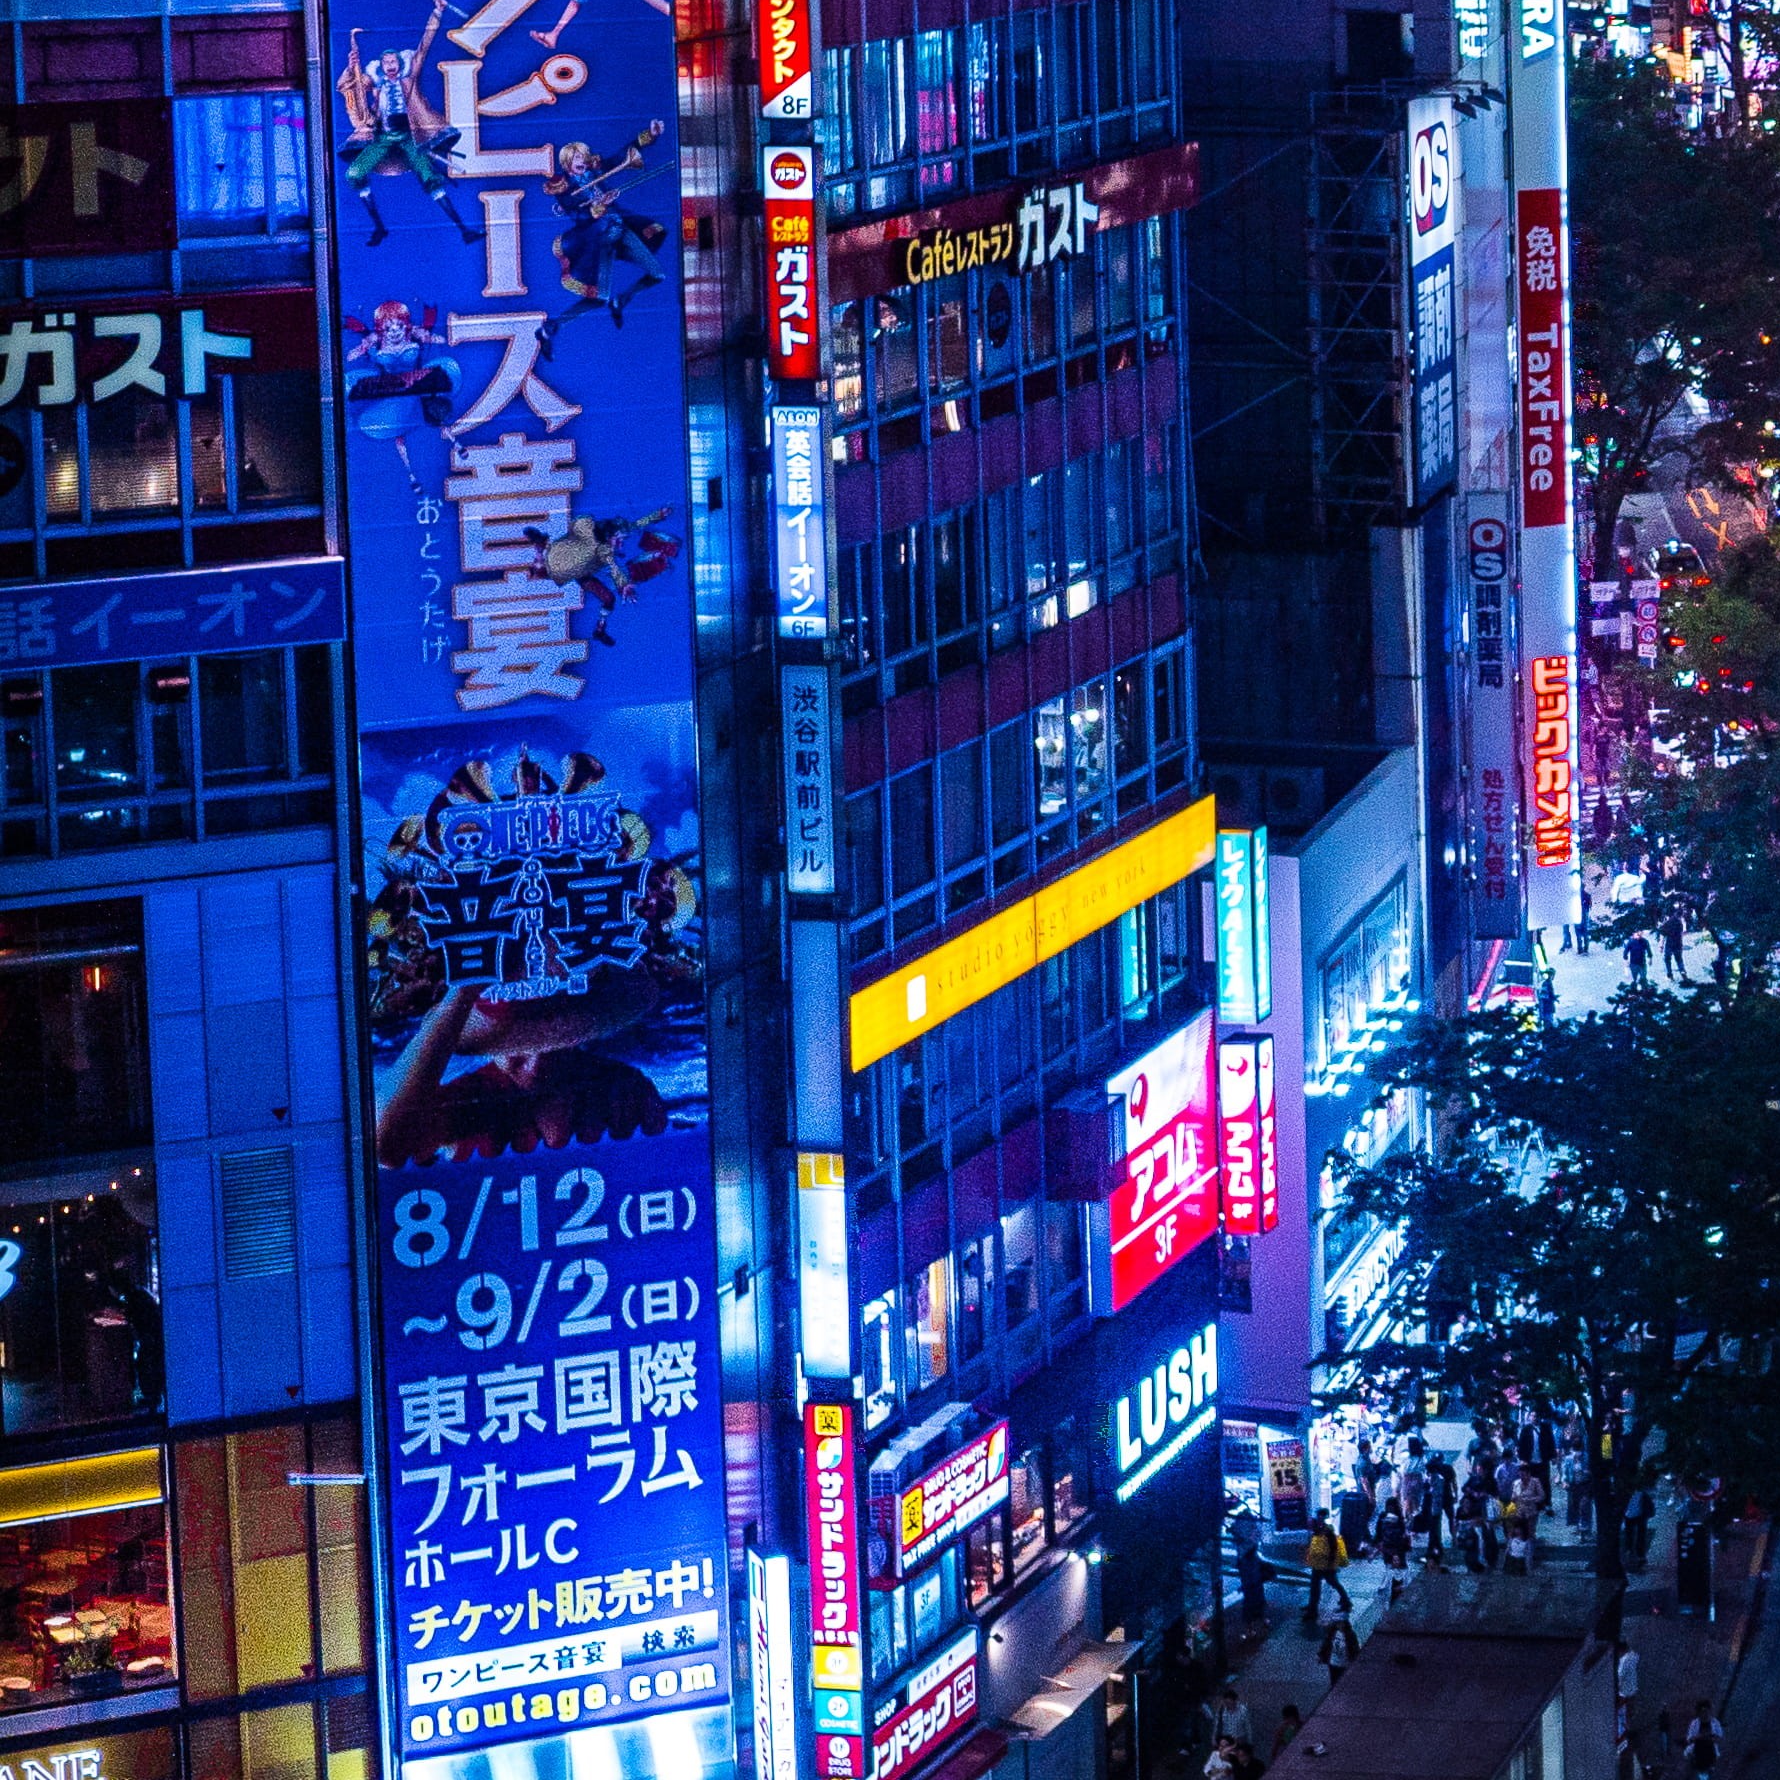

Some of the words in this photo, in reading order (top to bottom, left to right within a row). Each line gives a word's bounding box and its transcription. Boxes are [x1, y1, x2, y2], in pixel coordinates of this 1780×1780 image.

[781, 95, 808, 116] 8F
[1414, 126, 1450, 220] OS
[771, 216, 809, 232] Café
[1018, 182, 1100, 272] ガスト
[1525, 225, 1558, 293] 免税
[775, 247, 811, 358] ガスト
[0, 310, 252, 406] ガスト
[416, 497, 452, 664] おとうたげ
[791, 620, 816, 637] 6F
[791, 685, 824, 875] 渋谷駅前ビル
[1128, 1122, 1200, 1224] アコム
[1226, 1122, 1255, 1198] アコム
[393, 1167, 608, 1267] 8/12
[1154, 1222, 1179, 1265] 3F
[399, 1340, 698, 1457] 東京国際
[1117, 1322, 1218, 1473] LUSH
[401, 1425, 704, 1536] フォーラム
[816, 1471, 849, 1631] サンドラッグ
[410, 1658, 718, 1744] otoutage.com
[420, 1640, 608, 1694] ワンピース音宴
